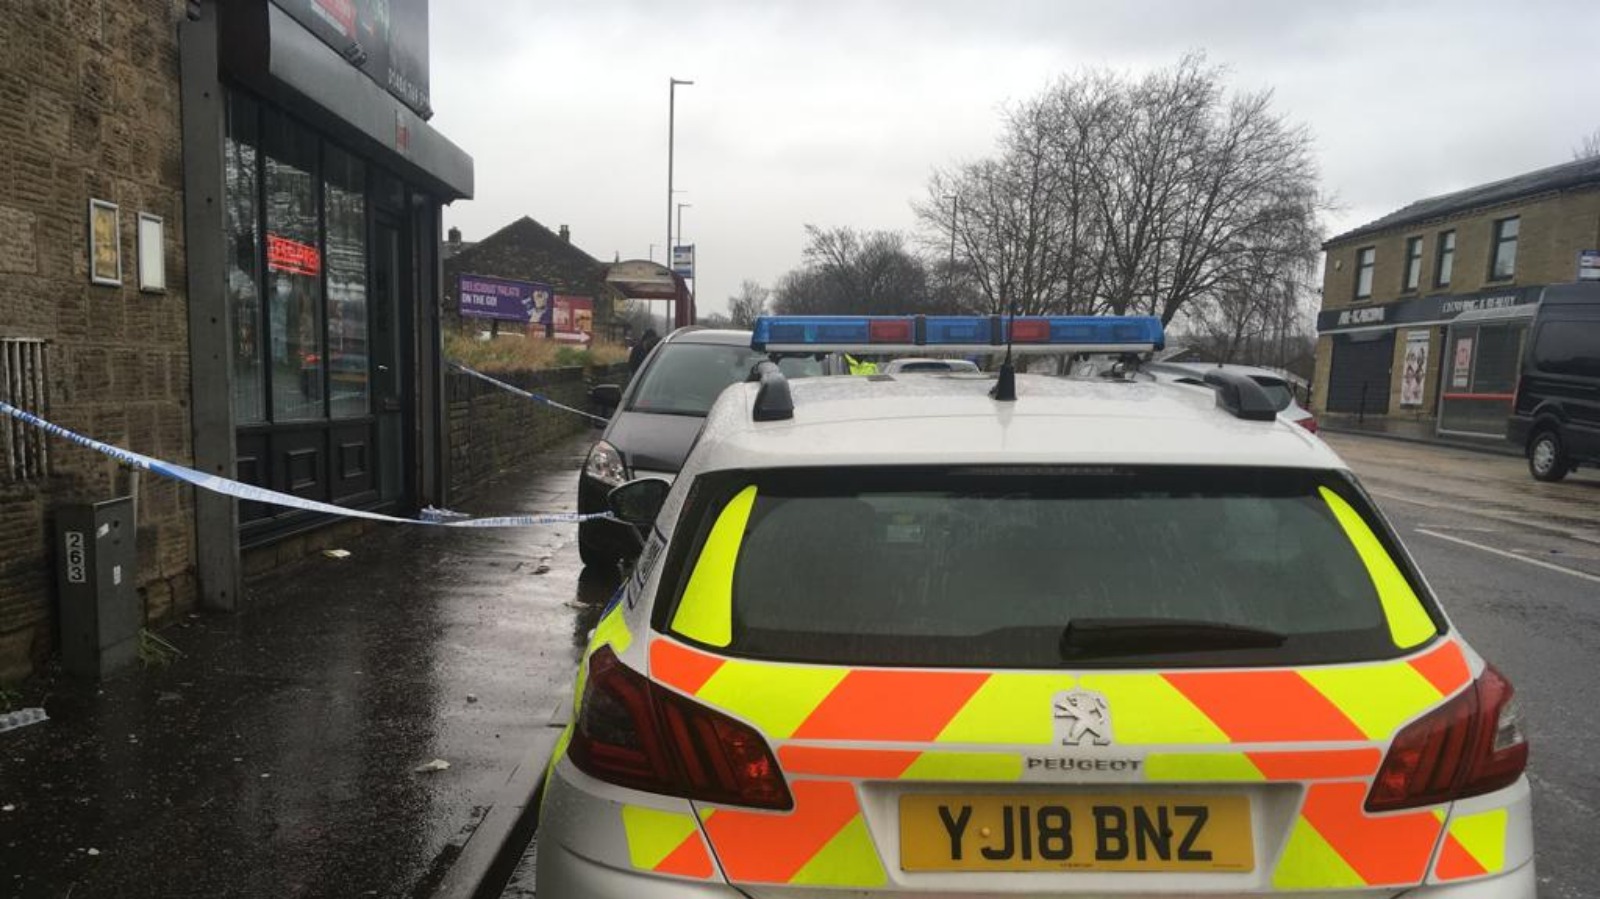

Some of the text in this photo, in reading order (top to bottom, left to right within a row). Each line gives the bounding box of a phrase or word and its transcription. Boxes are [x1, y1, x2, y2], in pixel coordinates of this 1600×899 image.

[473, 294, 485, 306] THE
[70, 534, 82, 580] 263
[1027, 757, 1141, 772] PEUGEOT
[938, 806, 1212, 861] YJ18 BNZ
